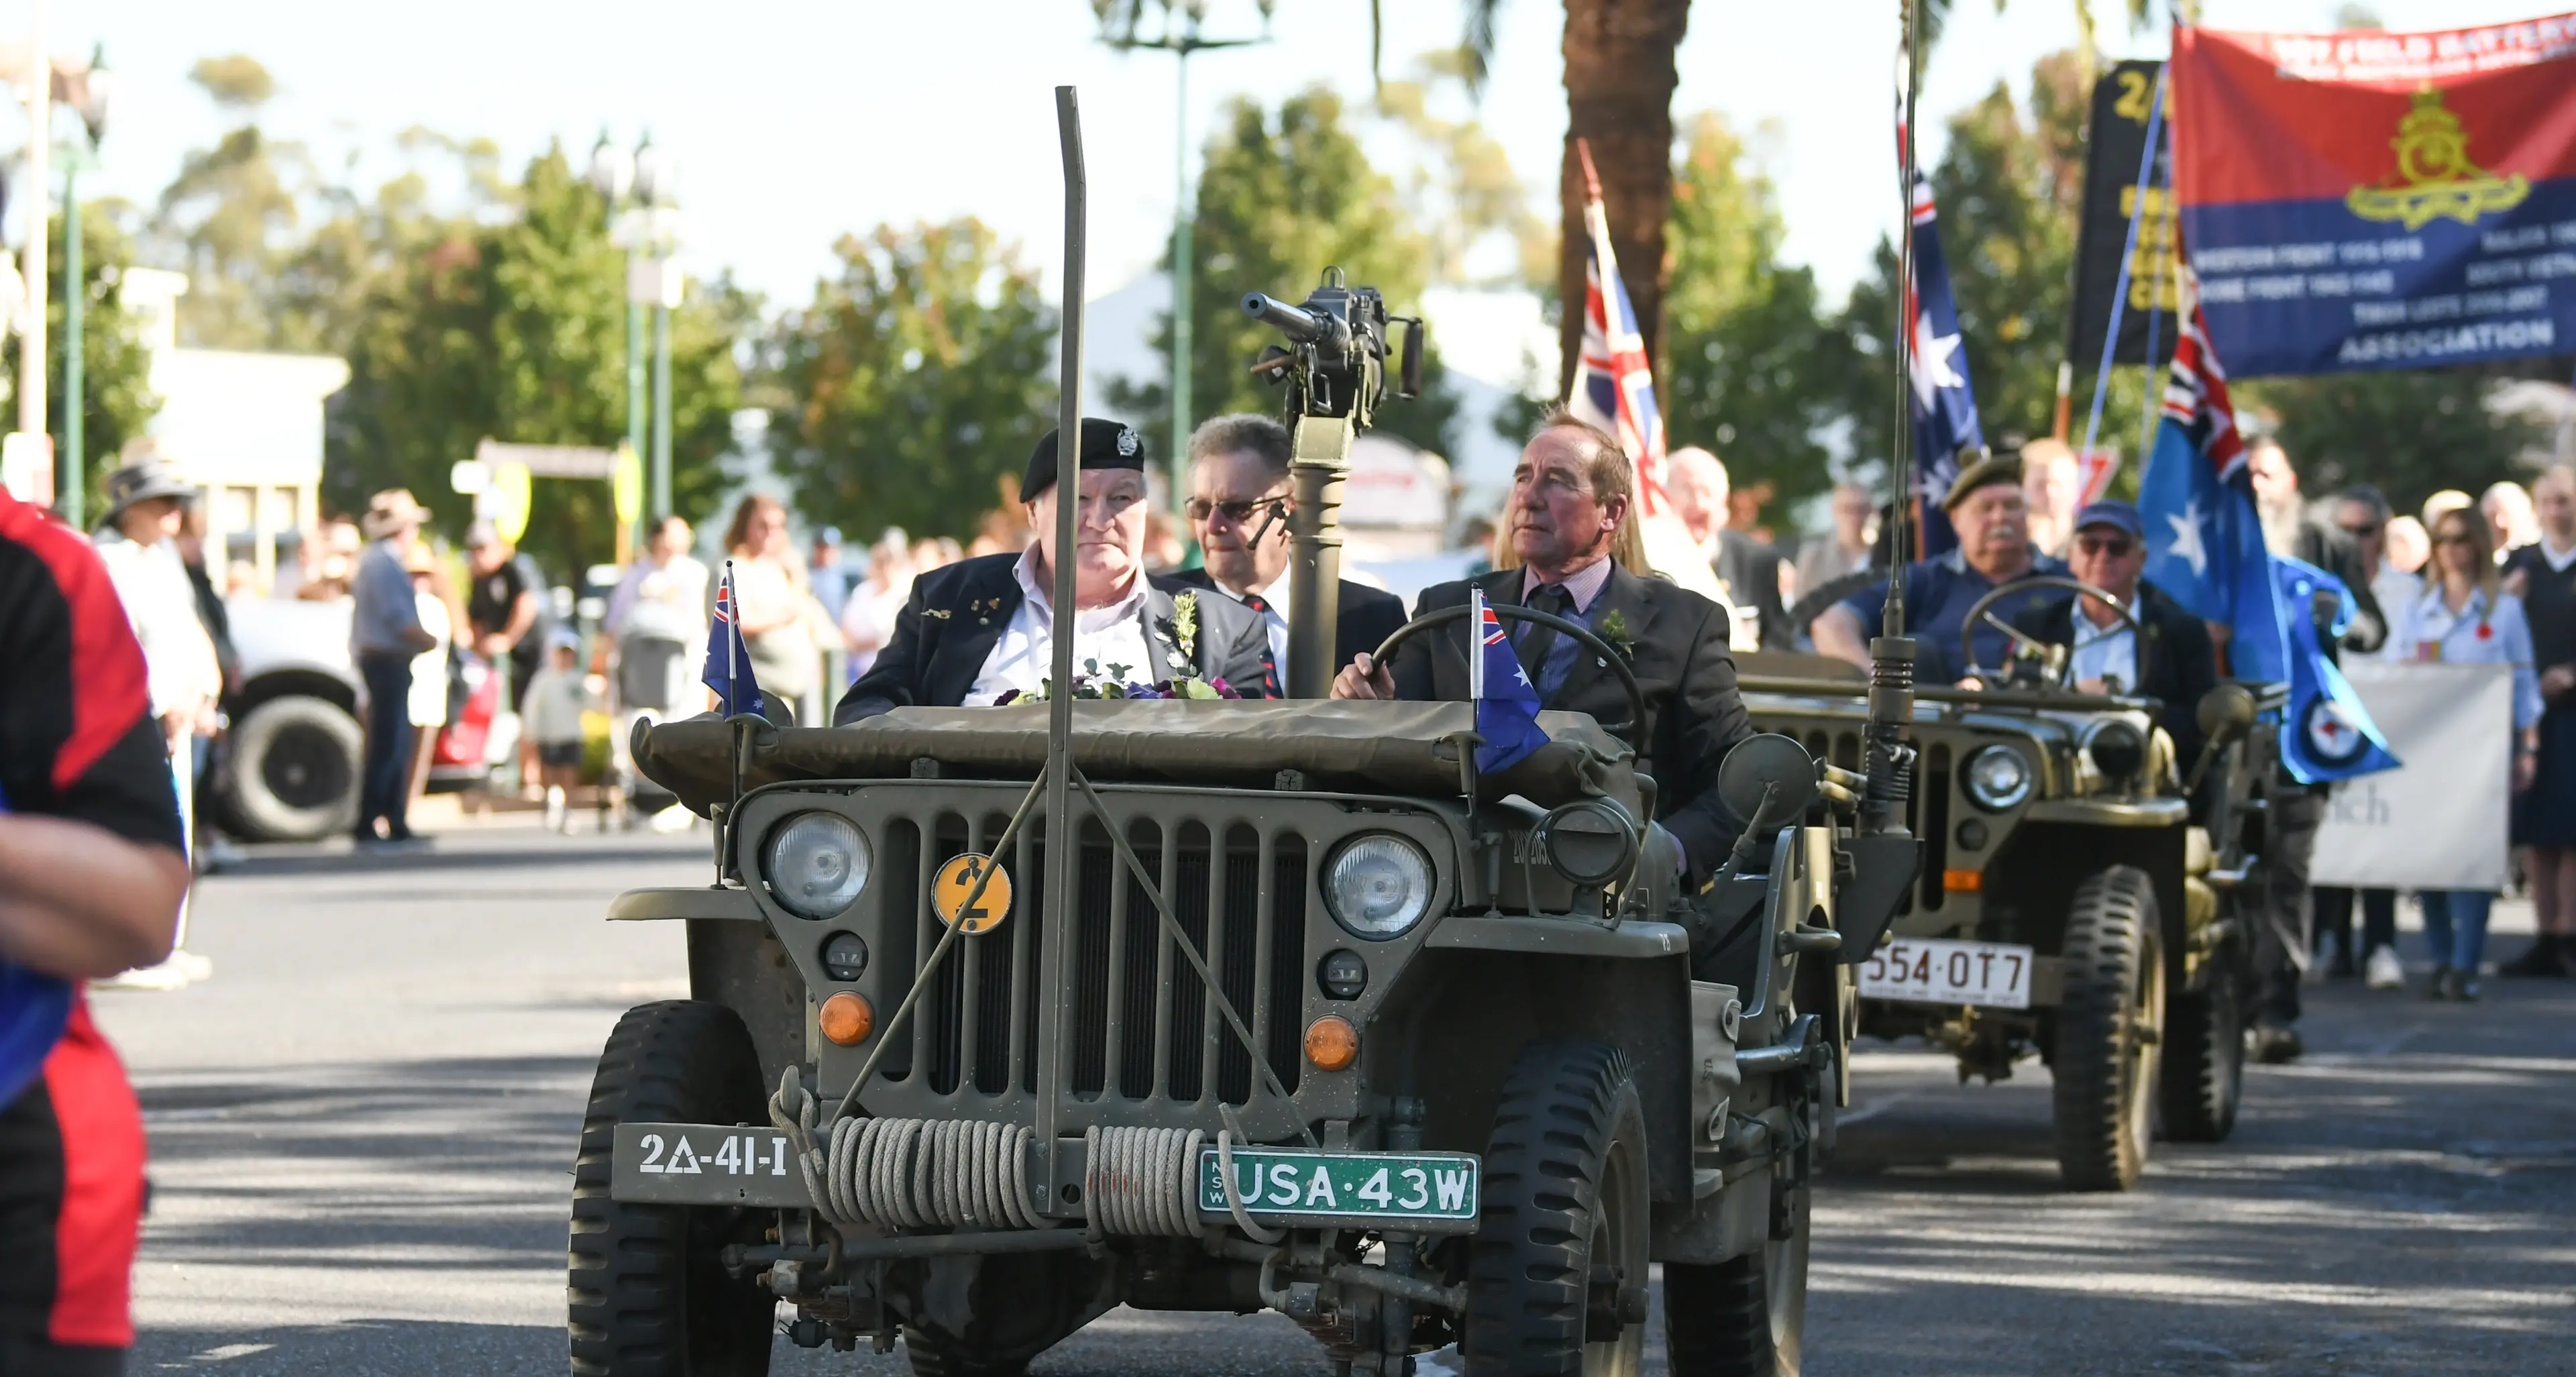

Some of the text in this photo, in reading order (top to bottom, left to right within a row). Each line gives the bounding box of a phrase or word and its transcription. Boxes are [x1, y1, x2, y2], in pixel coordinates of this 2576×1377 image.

[2276, 241, 2336, 267] FRONT
[2339, 319, 2553, 362] ASSOCIATION
[955, 866, 989, 918] 2
